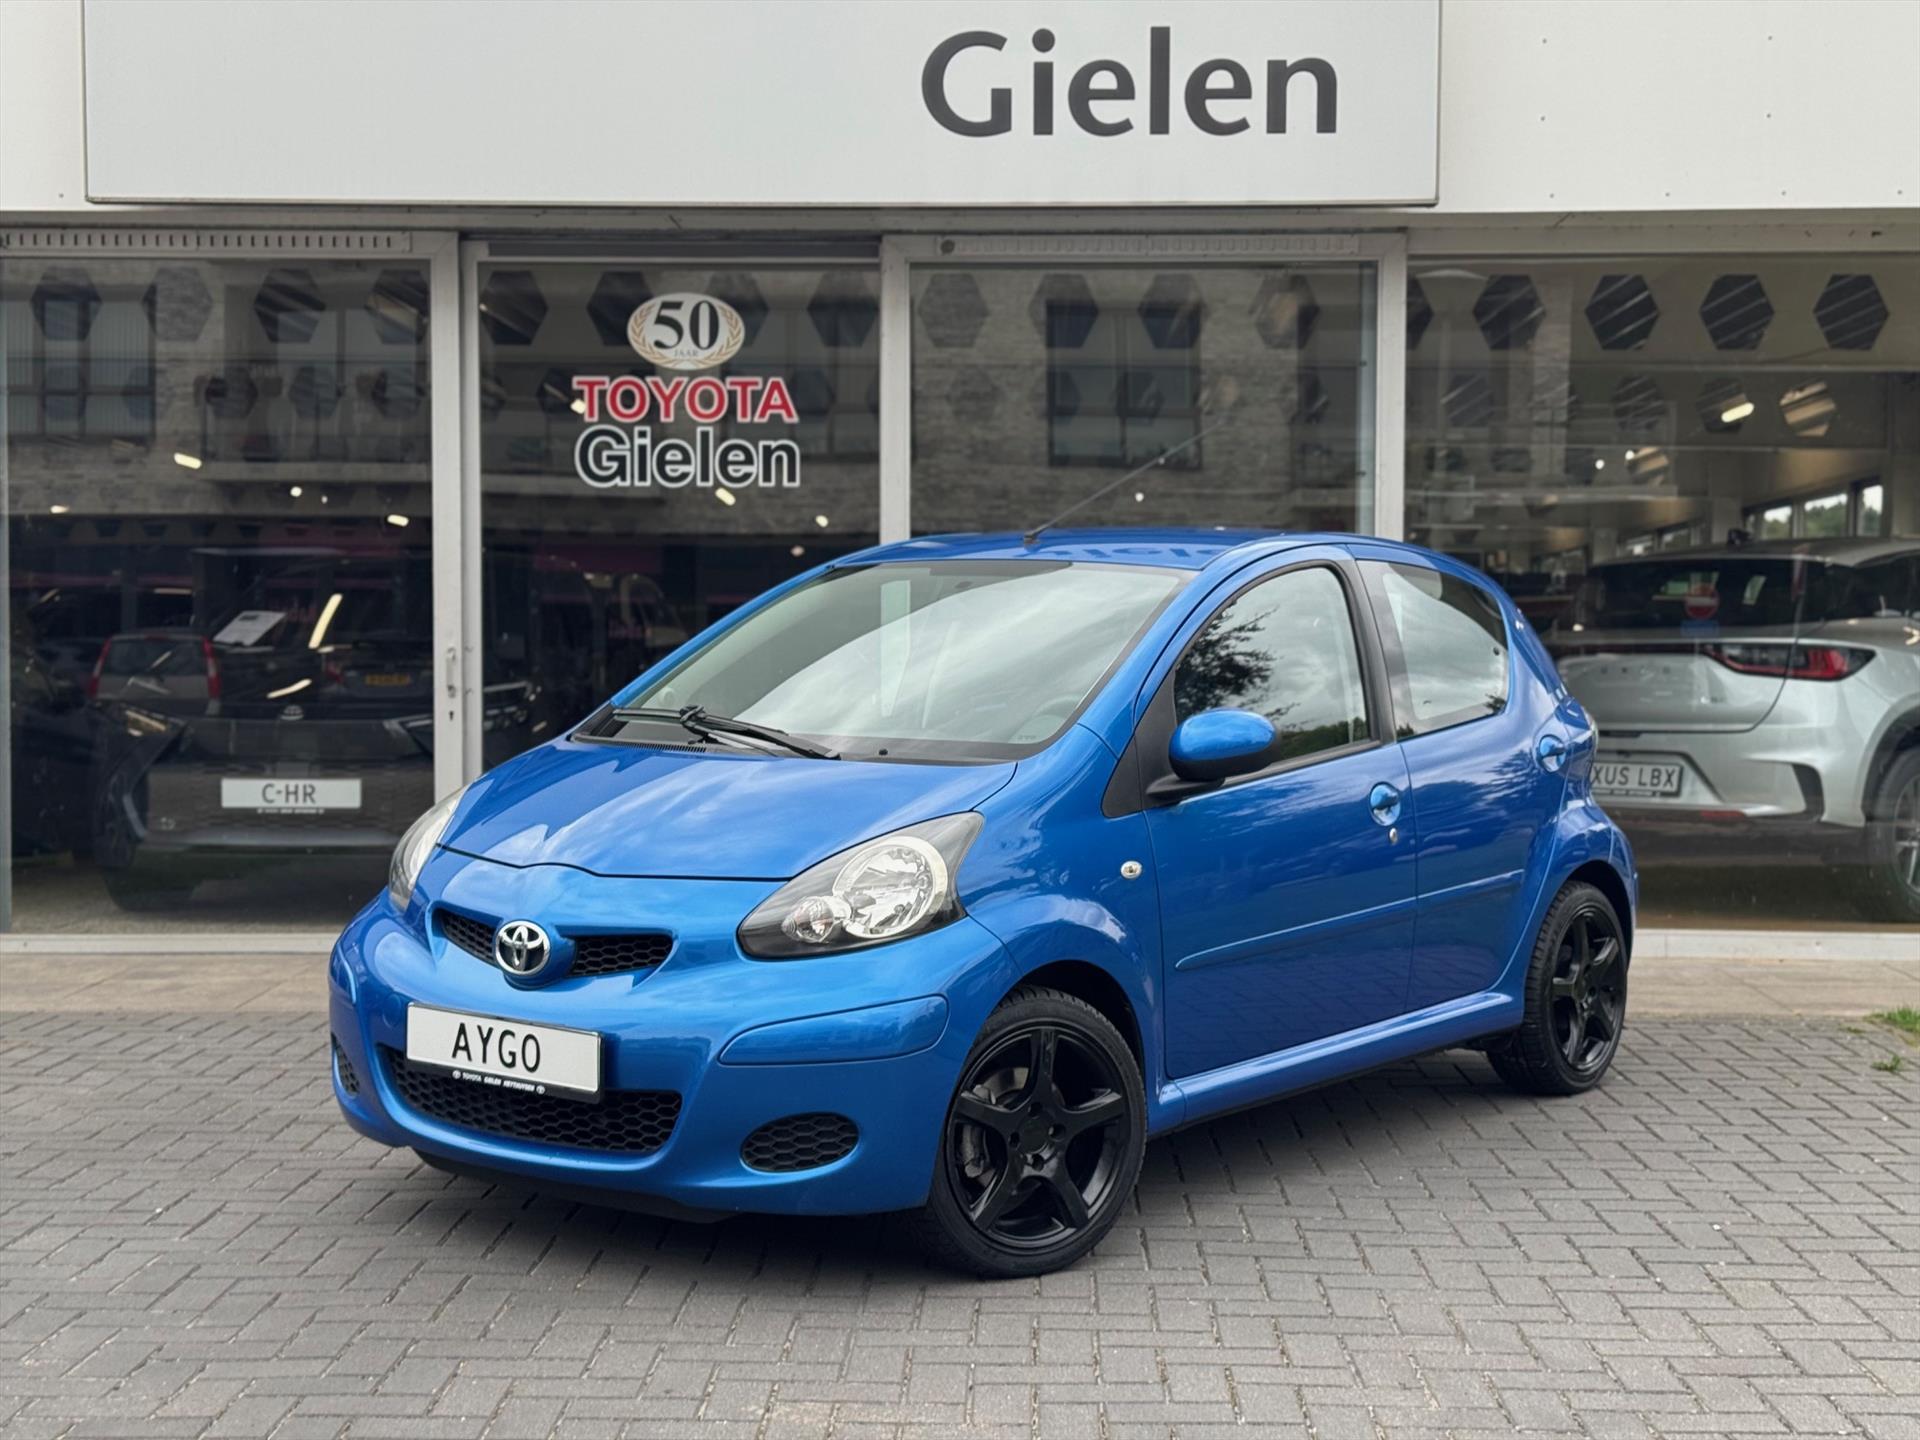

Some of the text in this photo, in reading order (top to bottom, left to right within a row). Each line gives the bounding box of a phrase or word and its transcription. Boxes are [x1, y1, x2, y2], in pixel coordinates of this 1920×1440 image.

[921, 26, 1338, 138] Gielen
[653, 300, 721, 351] 50
[572, 376, 799, 423] TOYOTA
[574, 424, 801, 488] Gielen
[261, 783, 317, 804] C-HR
[1638, 767, 1676, 788] LBX
[451, 1022, 541, 1074] AYGO
